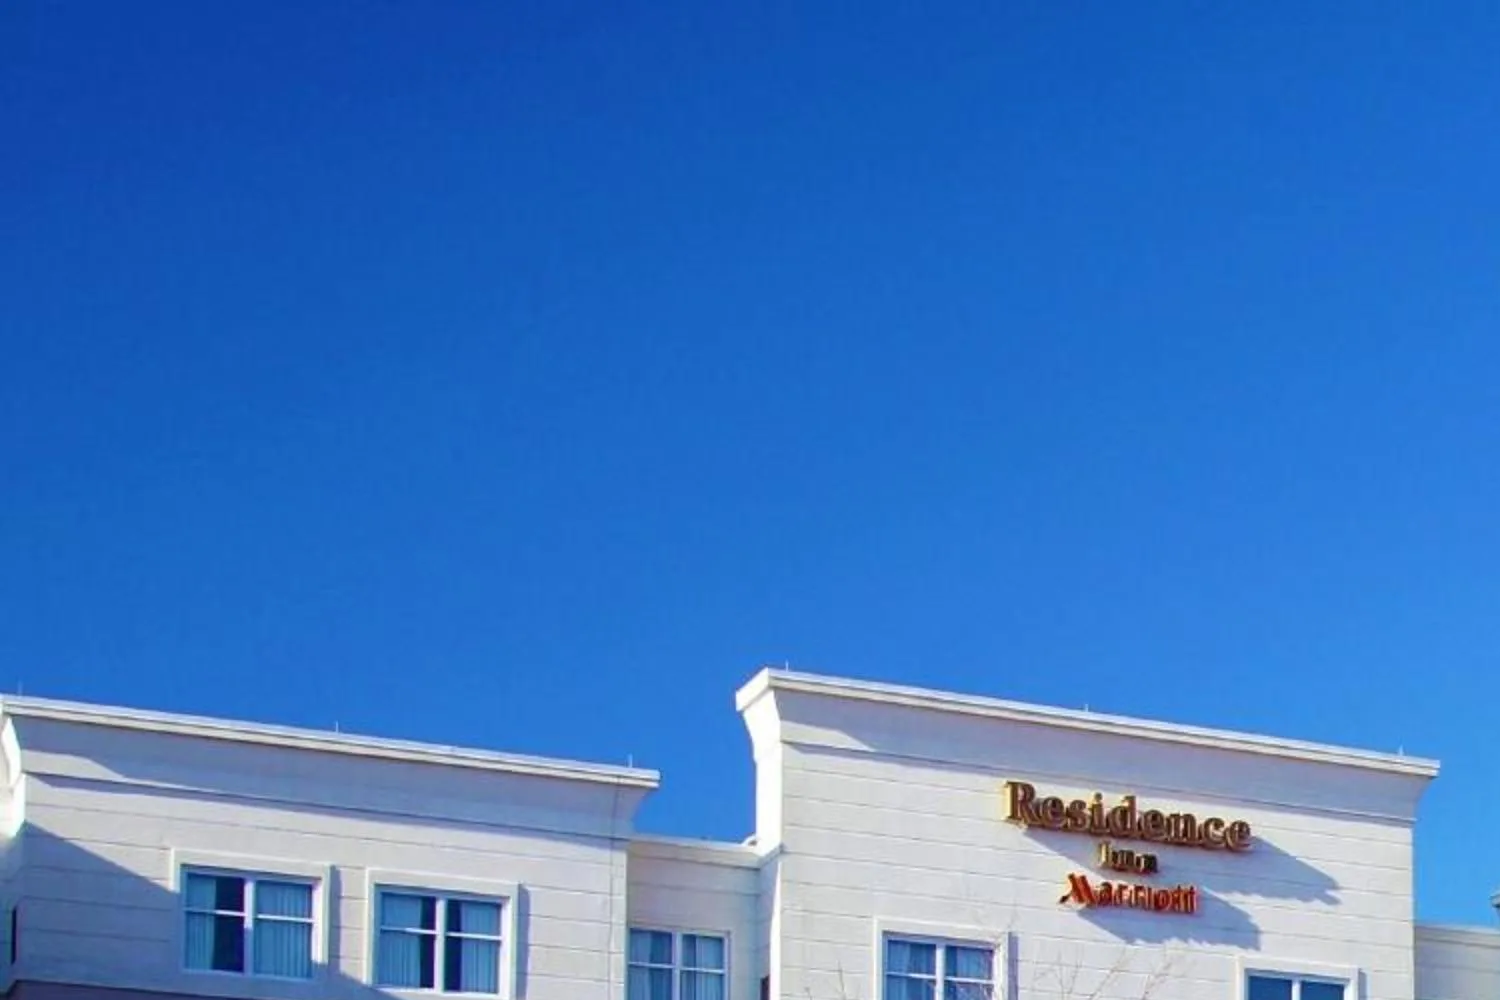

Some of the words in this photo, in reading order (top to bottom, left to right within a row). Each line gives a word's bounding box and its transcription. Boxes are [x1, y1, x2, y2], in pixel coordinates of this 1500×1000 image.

[1004, 780, 1251, 848] Residence
[1099, 842, 1158, 873] Inn
[1059, 872, 1197, 913] Marriott
